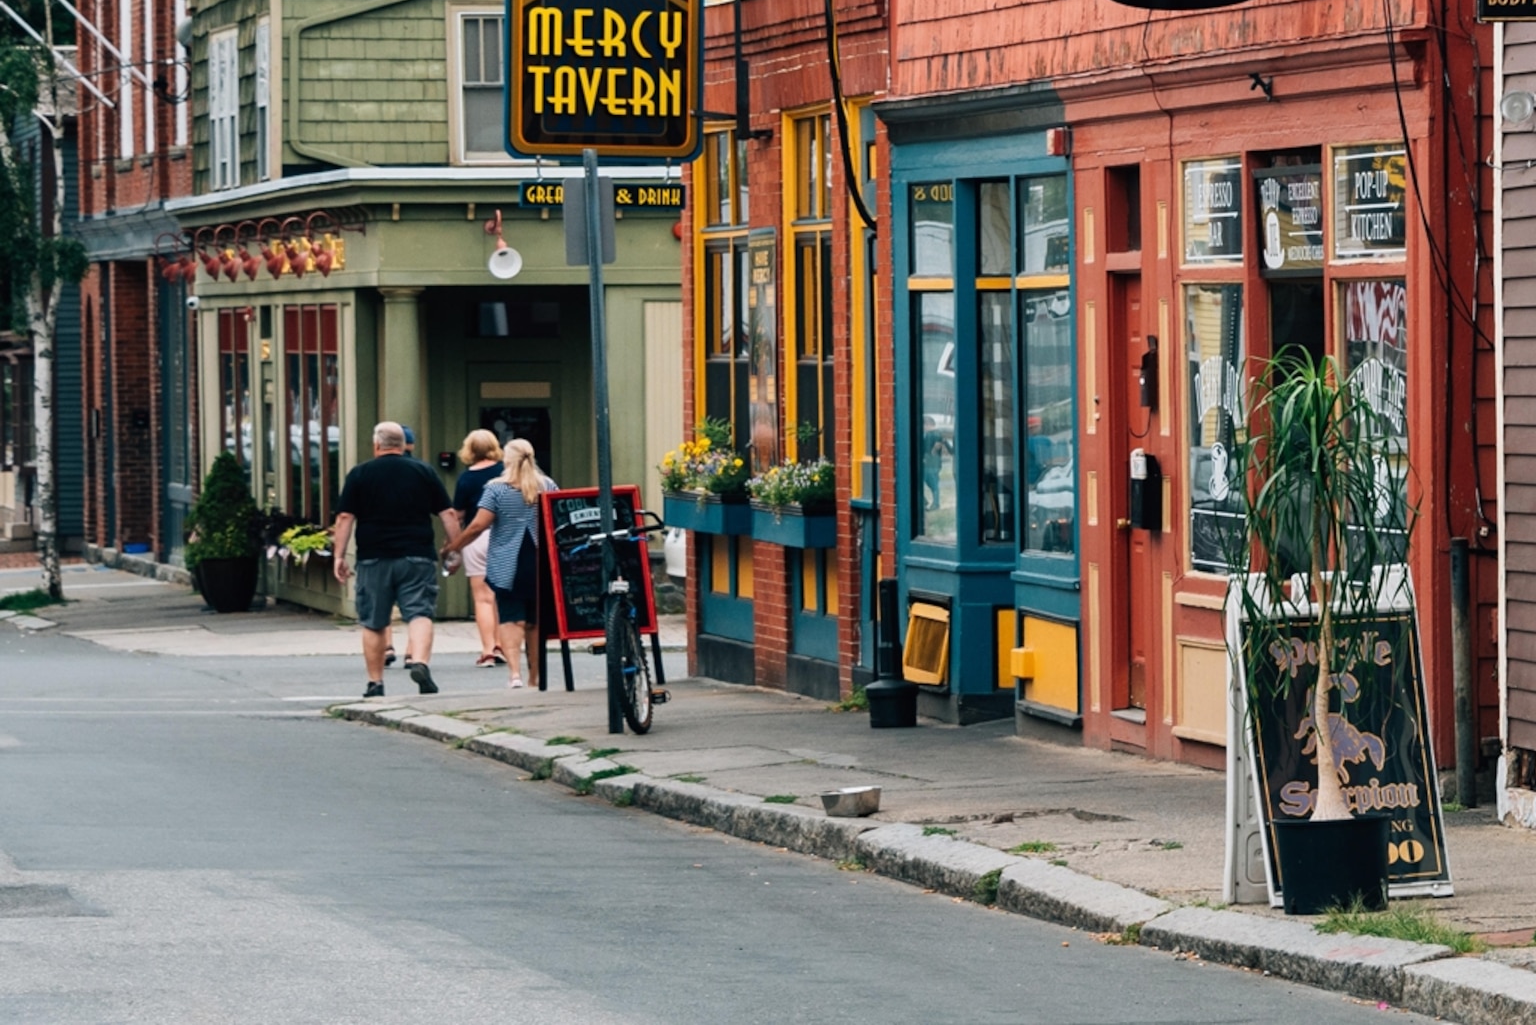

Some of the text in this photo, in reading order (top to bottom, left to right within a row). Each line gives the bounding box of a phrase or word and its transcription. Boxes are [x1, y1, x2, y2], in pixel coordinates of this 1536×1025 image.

[528, 7, 683, 59] MERCY
[527, 65, 682, 117] TAVERN
[615, 188, 633, 204] &
[638, 187, 681, 205] DRINK
[1354, 171, 1389, 199] POP-UP
[1351, 212, 1392, 241] KITCHEN
